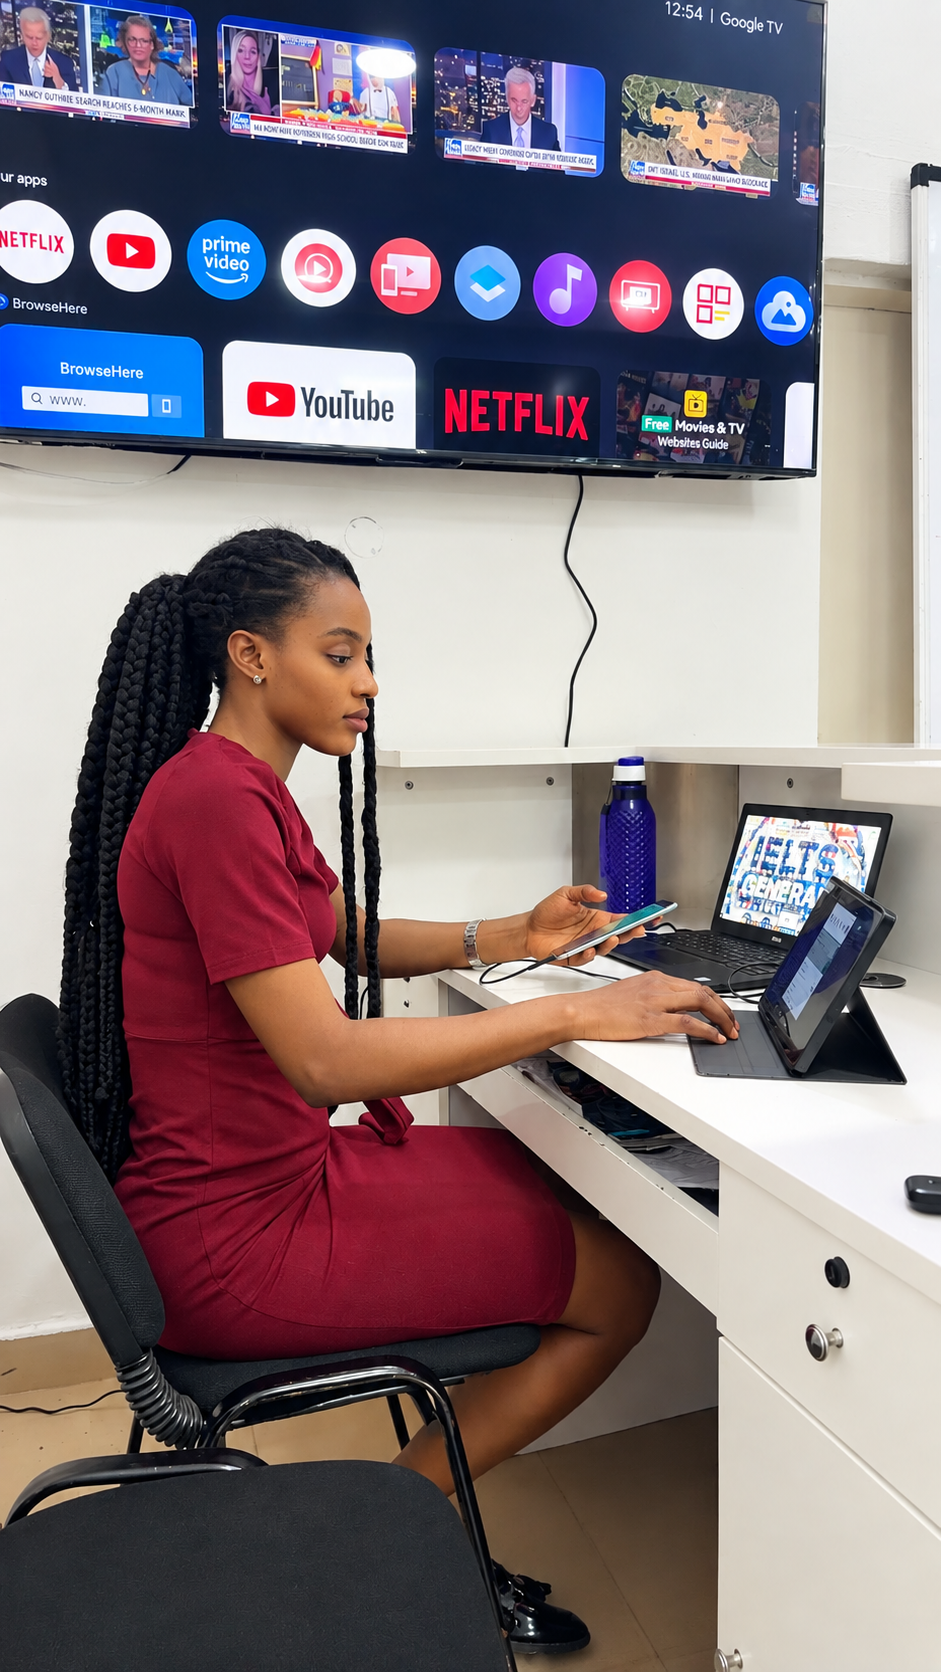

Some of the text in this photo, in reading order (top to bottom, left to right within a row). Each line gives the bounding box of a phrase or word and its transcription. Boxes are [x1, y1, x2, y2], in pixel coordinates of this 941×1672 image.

[665, 1, 783, 35] 12:54 Google TV
[19, 88, 43, 99] NANCY
[102, 100, 132, 112] REACHES
[17, 174, 48, 188] apps
[0, 230, 64, 254] NETFLIX
[202, 235, 251, 254] prime
[203, 253, 250, 271] video
[12, 297, 88, 314] BrowseHere
[60, 361, 144, 379] BrowseHere
[300, 385, 395, 422] YouTube
[444, 388, 590, 441] NETFLIX
[644, 417, 746, 435] Free Movies & TV
[657, 435, 729, 450] Websites Guide
[750, 835, 839, 884] IELTS
[741, 872, 829, 908] GENERA
